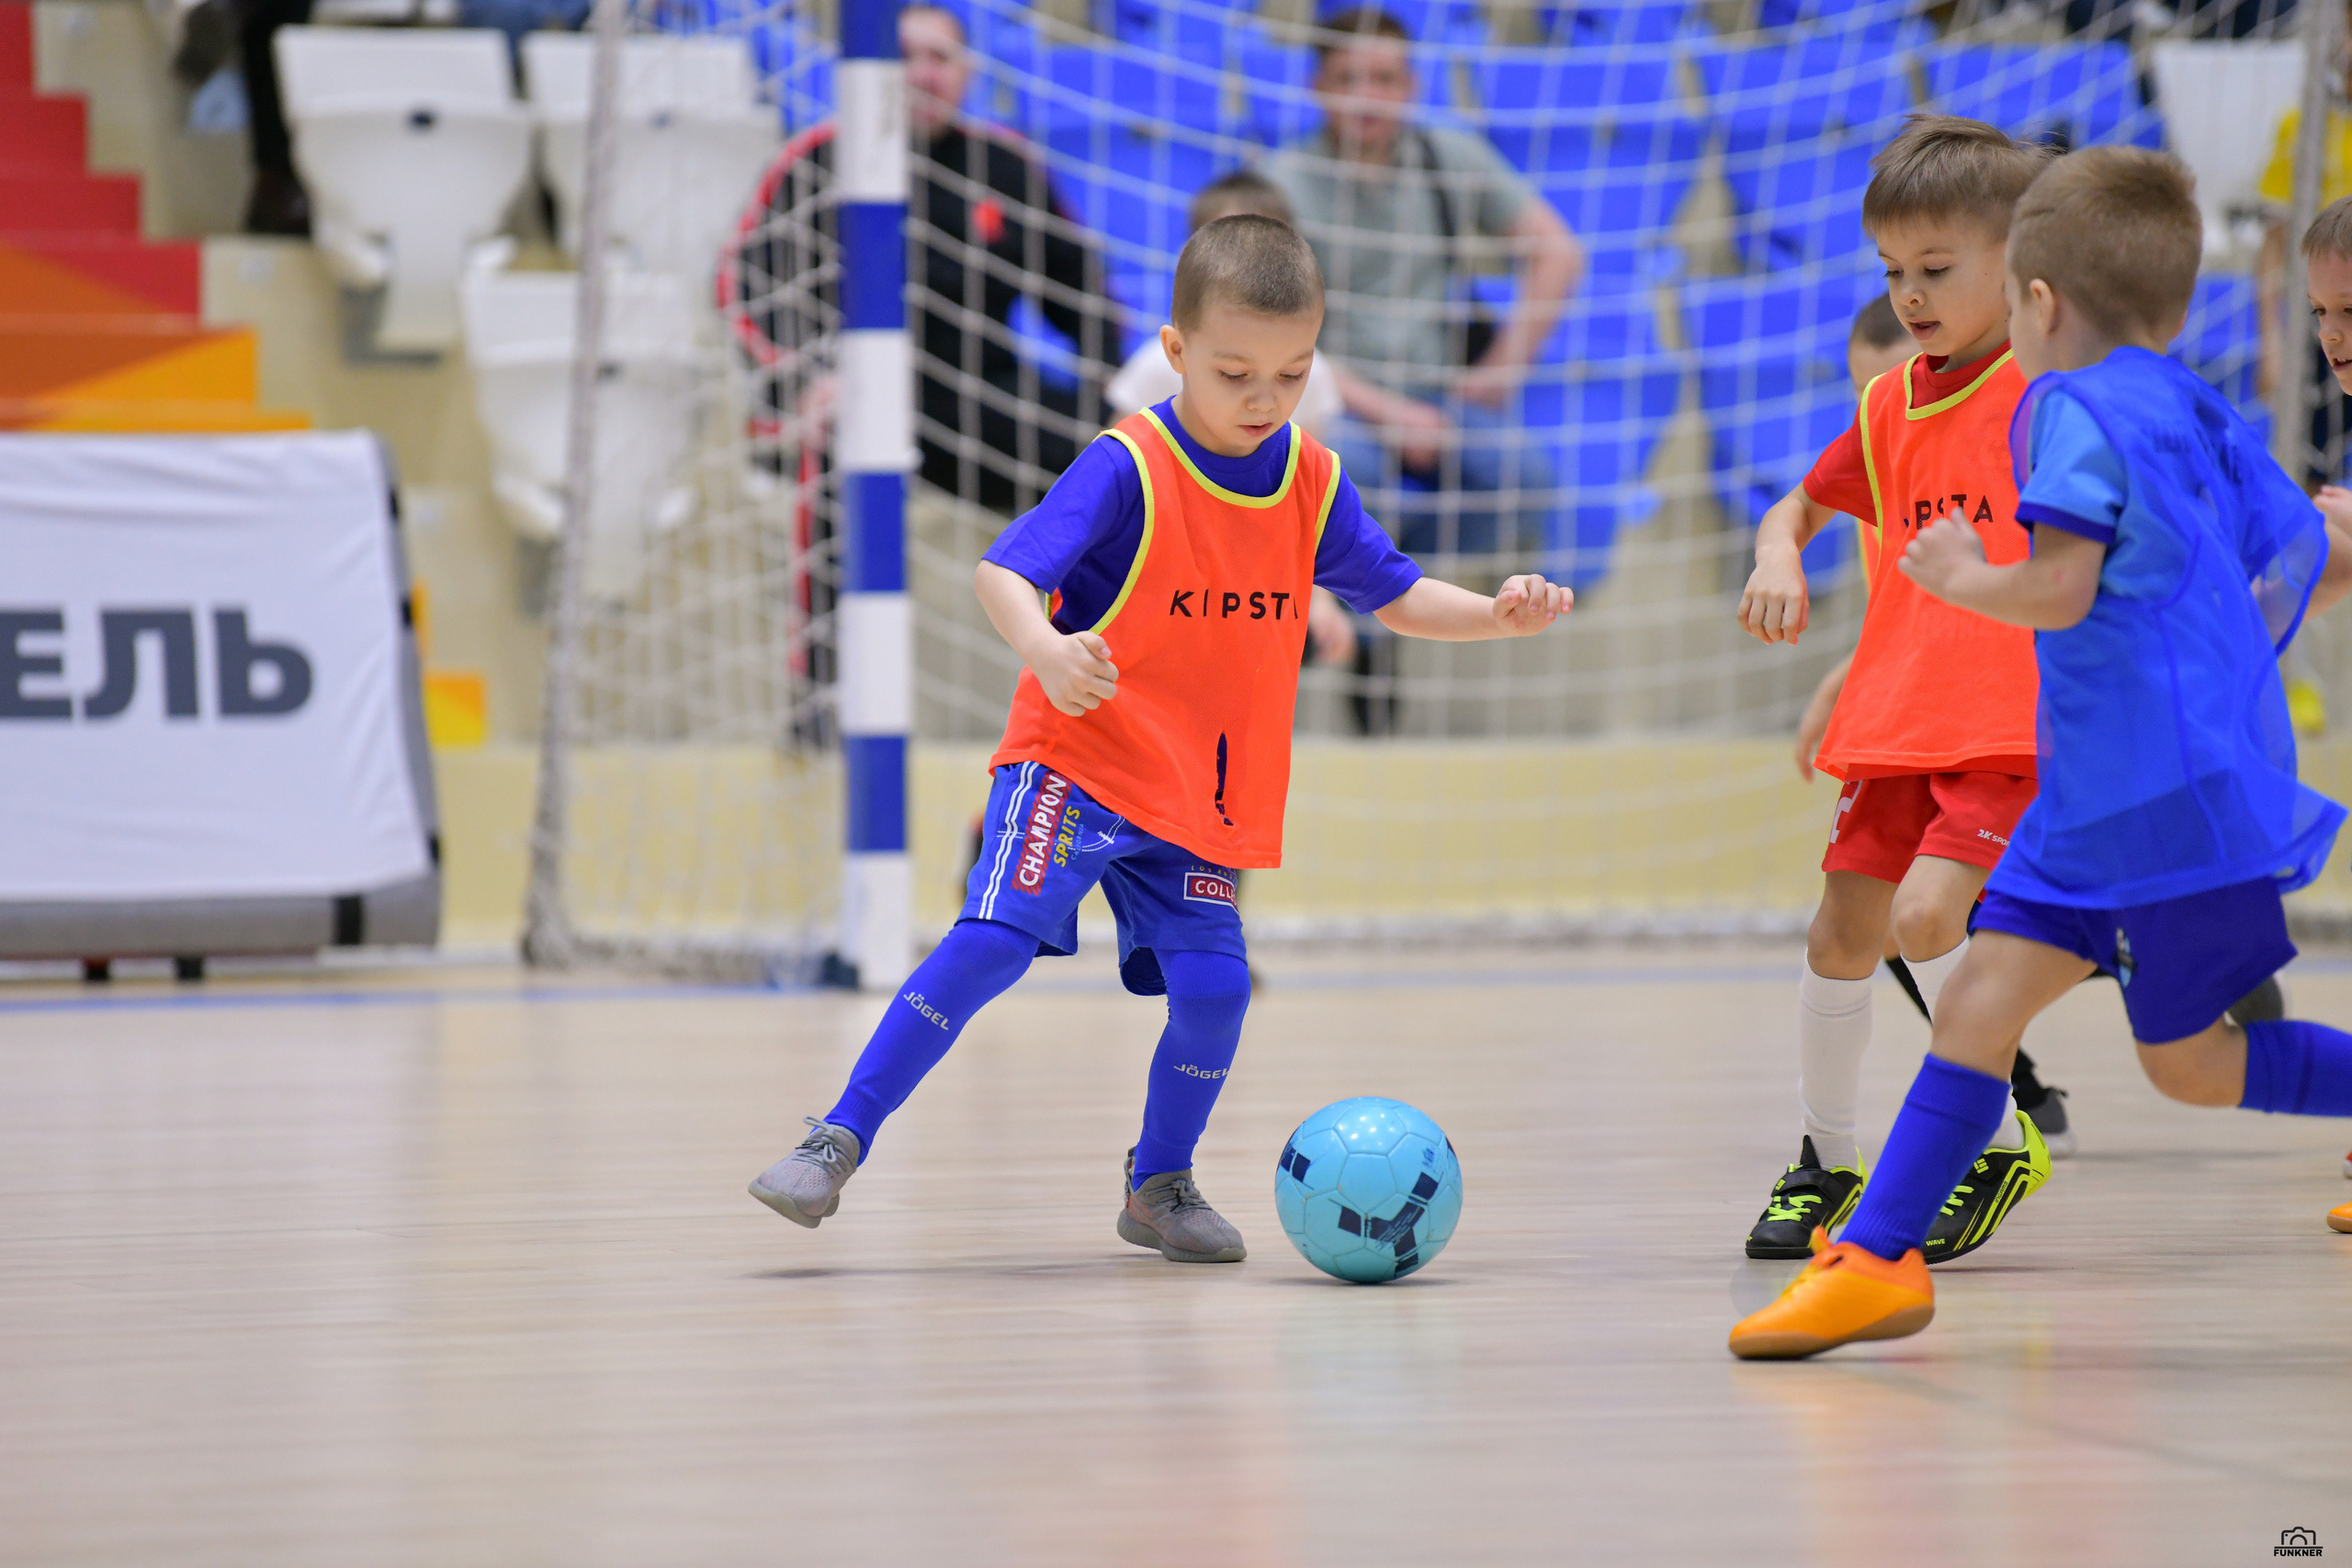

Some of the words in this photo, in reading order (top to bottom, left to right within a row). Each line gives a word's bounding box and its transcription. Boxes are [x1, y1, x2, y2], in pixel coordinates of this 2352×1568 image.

[1170, 589, 1298, 620] KIPST
[0, 606, 314, 721] ЕЛЬ
[1019, 774, 1067, 886] CHAMPION
[1053, 805, 1080, 868] SPRITS
[1195, 880, 1235, 903] COLL
[903, 991, 949, 1031] JÖGEL
[1926, 1238, 1946, 1247] WAVE
